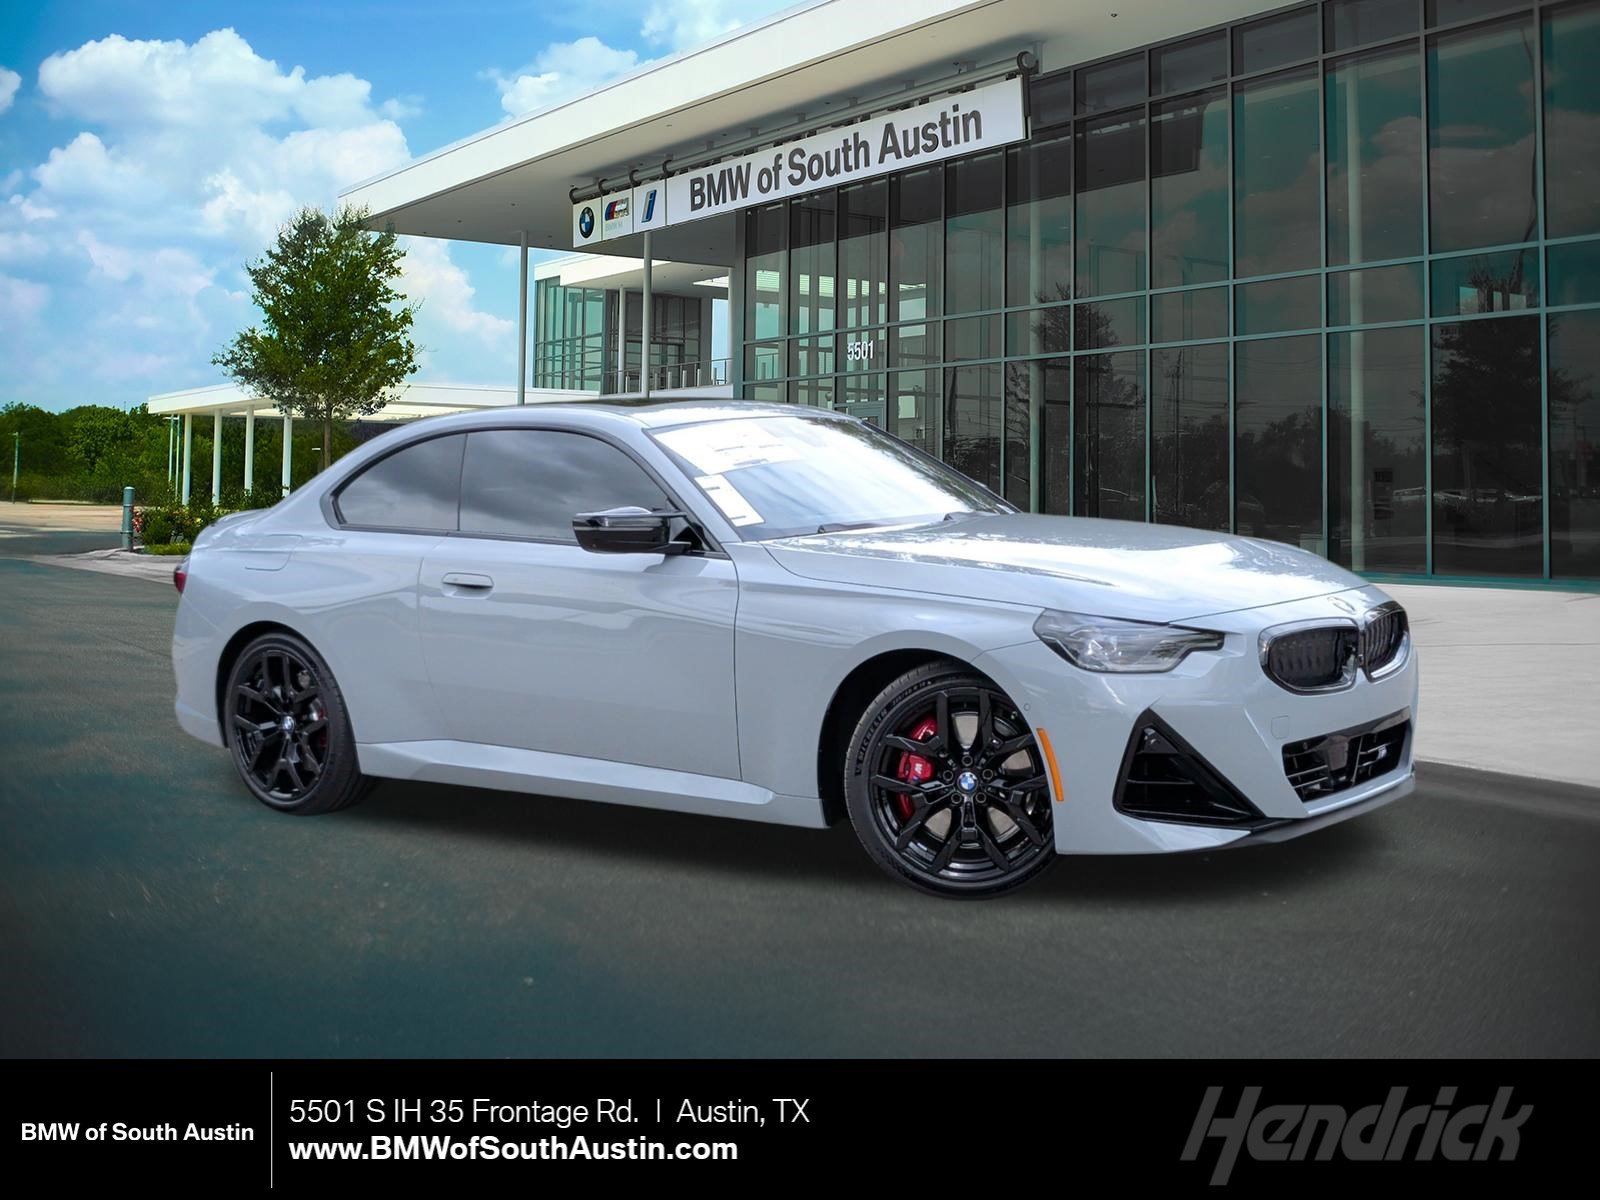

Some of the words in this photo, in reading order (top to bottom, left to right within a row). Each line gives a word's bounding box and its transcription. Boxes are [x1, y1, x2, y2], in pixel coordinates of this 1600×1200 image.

[690, 162, 751, 212] BMW
[757, 153, 783, 194] of
[787, 131, 870, 186] South
[878, 104, 982, 164] Austin
[847, 340, 873, 360] 5501
